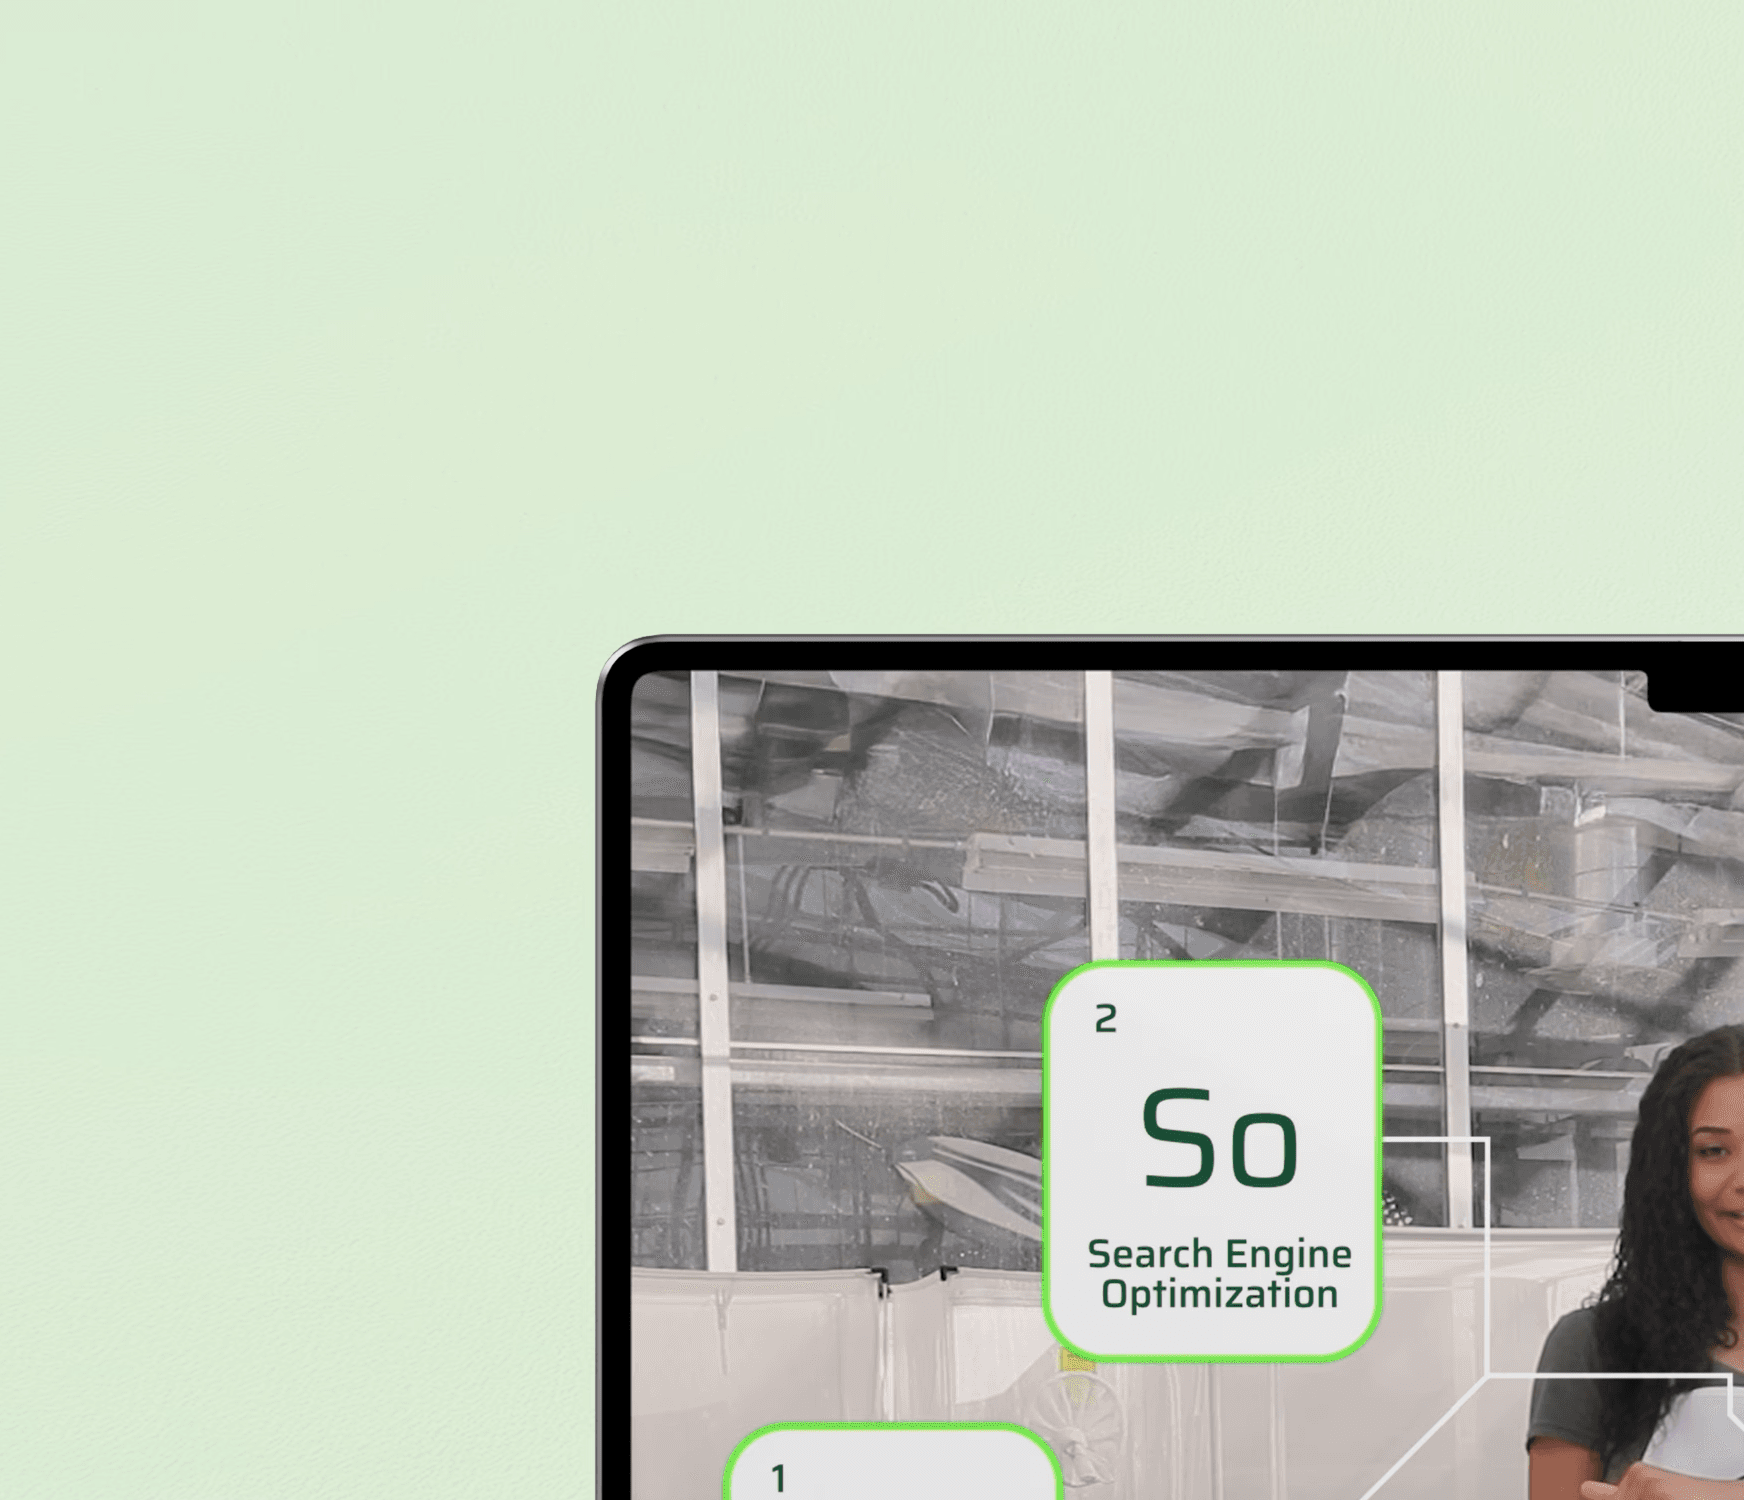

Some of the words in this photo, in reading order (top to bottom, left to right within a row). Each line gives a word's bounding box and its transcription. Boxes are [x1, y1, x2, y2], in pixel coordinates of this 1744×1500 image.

[1095, 1003, 1117, 1033] 2
[1143, 1087, 1297, 1188] So
[1088, 1236, 1213, 1269] Search
[1226, 1236, 1352, 1276] Engine
[1102, 1278, 1338, 1316] Optimization
[771, 1463, 784, 1493] 1
